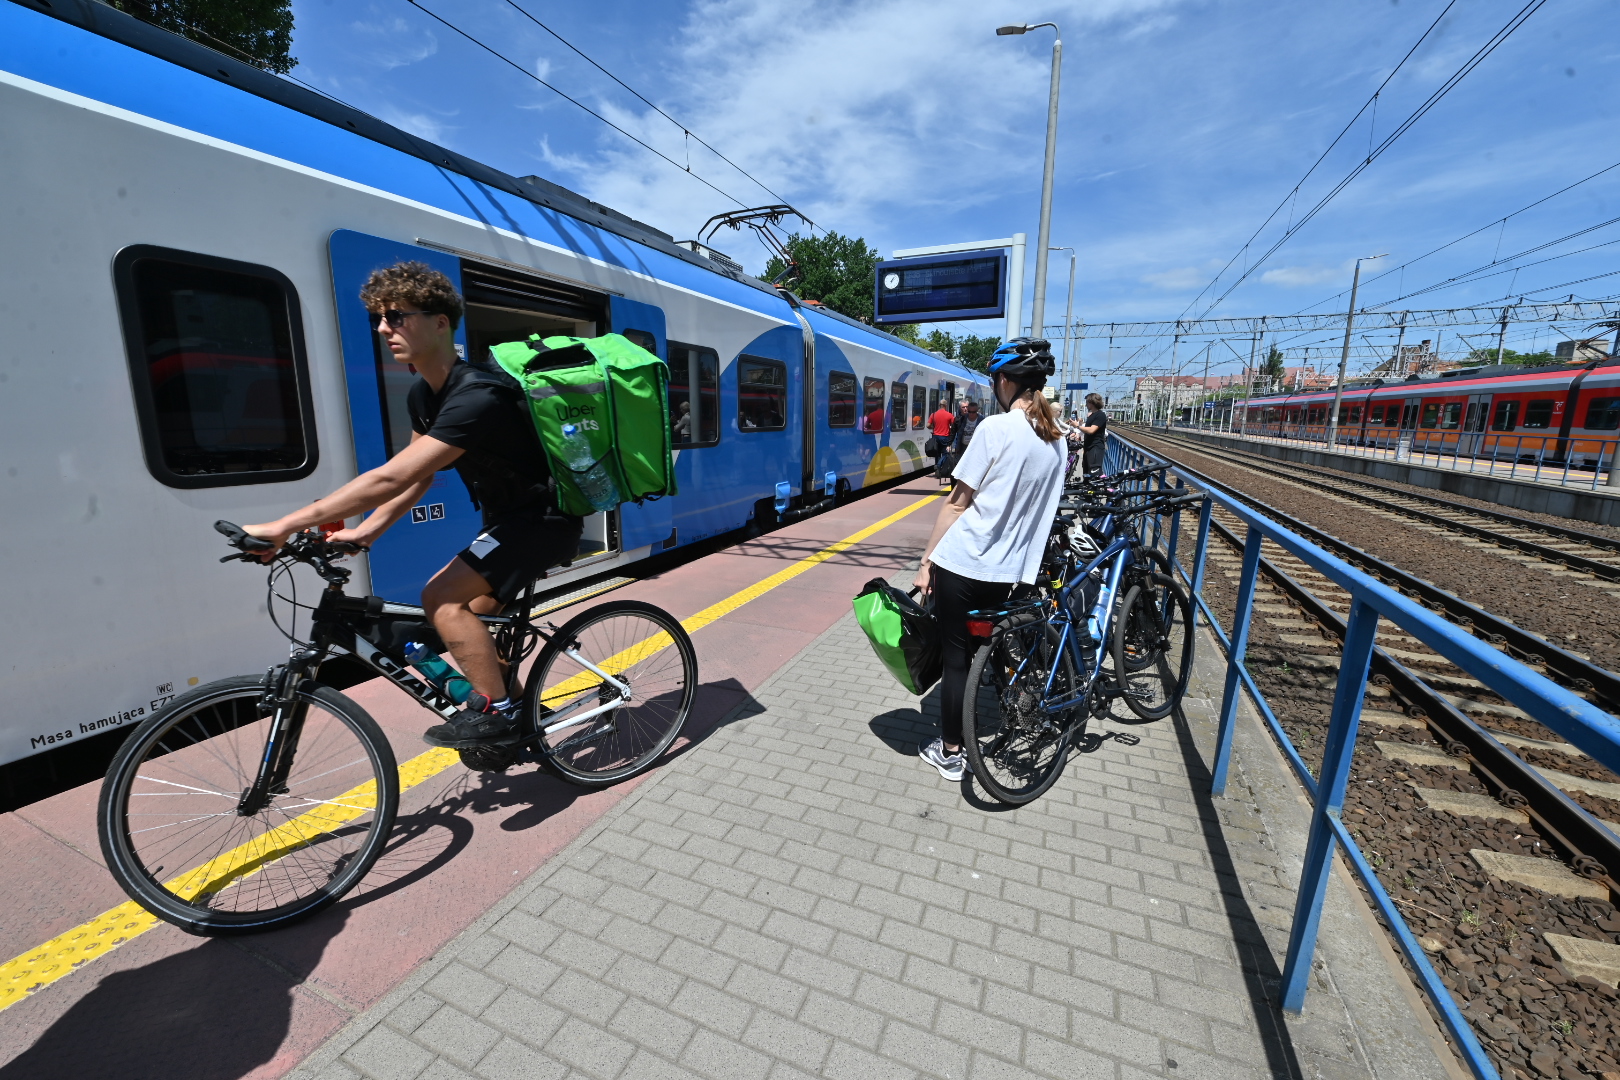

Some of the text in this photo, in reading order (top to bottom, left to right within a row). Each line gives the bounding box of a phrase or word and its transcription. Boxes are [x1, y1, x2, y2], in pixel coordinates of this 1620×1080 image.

[556, 404, 596, 421] Uber
[158, 682, 172, 694] WC
[30, 729, 73, 750] Masa
[79, 706, 146, 734] hamująca
